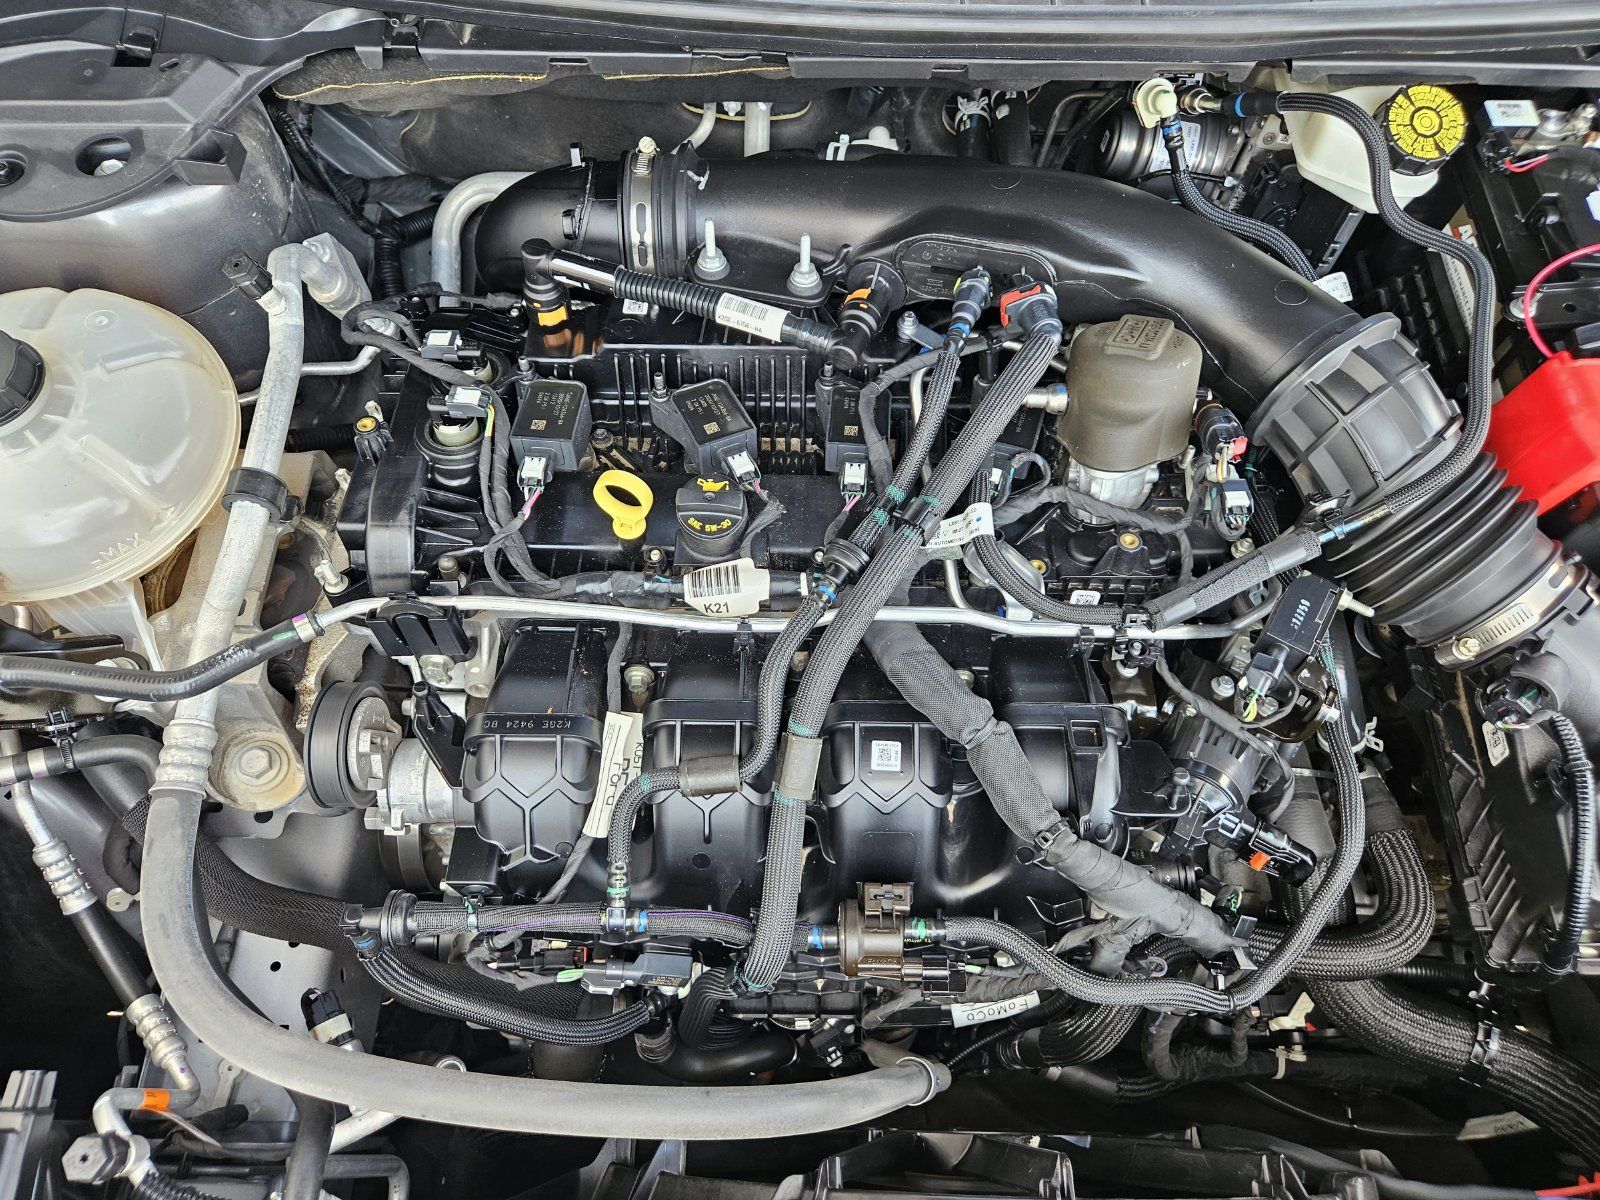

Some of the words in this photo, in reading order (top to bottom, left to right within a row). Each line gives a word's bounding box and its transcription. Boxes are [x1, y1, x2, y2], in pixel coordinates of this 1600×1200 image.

[687, 517, 703, 530] SAE
[704, 519, 732, 532] 5W-30
[703, 602, 730, 614] K21
[483, 719, 498, 729] BC
[505, 719, 534, 729] 9424
[541, 719, 571, 729] K2GE
[966, 998, 1029, 1021] FoMoCo
